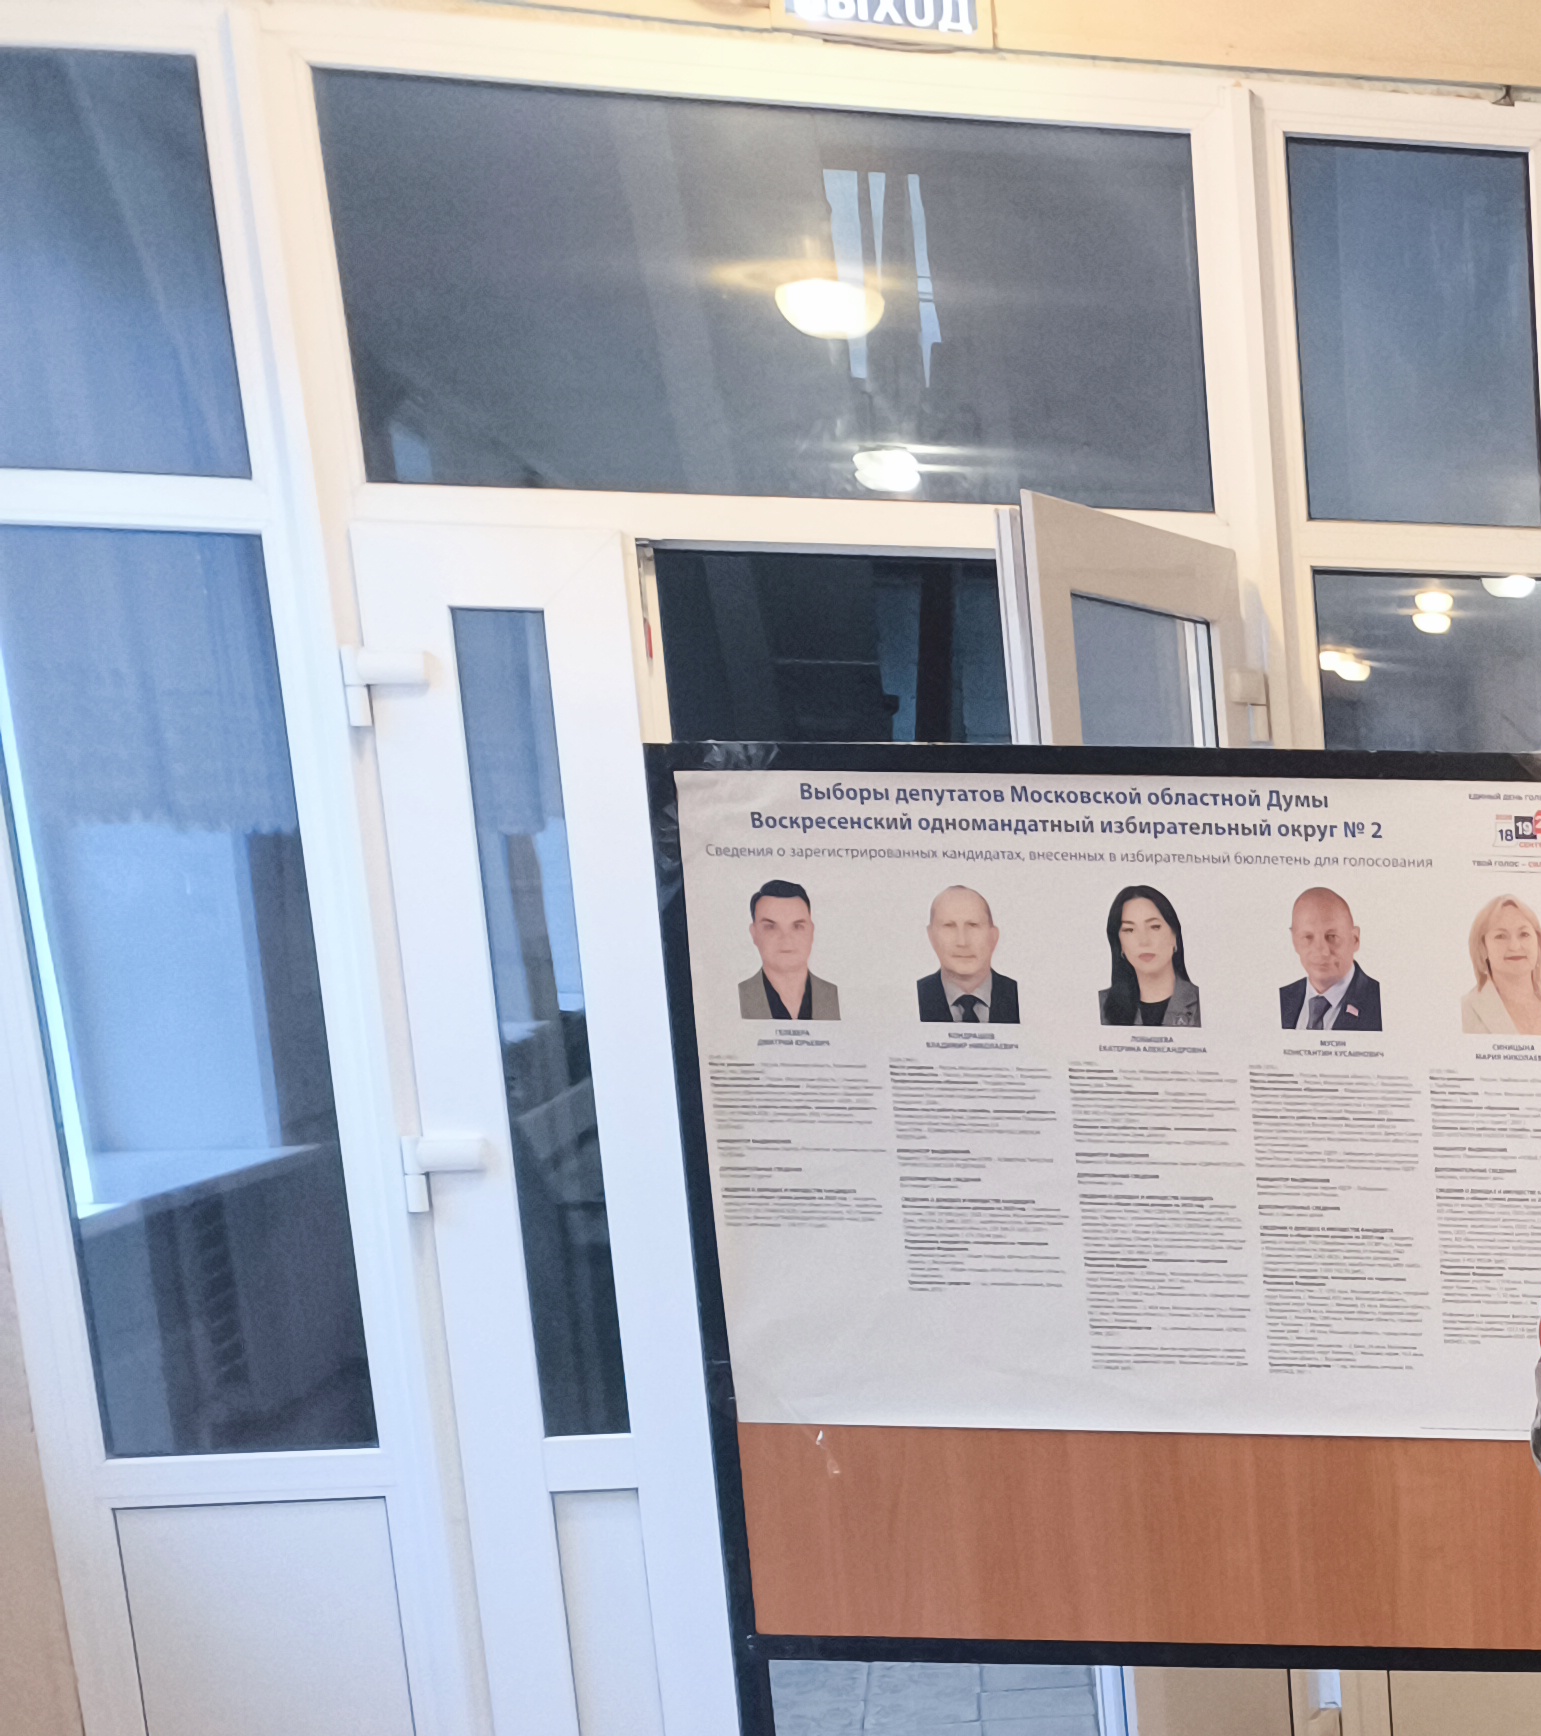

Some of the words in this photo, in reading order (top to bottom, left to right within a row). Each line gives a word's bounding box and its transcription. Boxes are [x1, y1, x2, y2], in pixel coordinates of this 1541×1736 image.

[800, 783, 889, 802] Выборы
[896, 786, 1005, 806] депутатов
[1010, 786, 1141, 805] Московской
[1148, 788, 1260, 808] областной
[1267, 790, 1328, 812] Думы
[750, 811, 912, 833] Воскресенский
[918, 816, 1094, 836] одномандатный
[1100, 816, 1271, 838] избирательный
[1277, 823, 1337, 842] округ
[1344, 822, 1364, 838] №
[1371, 822, 1383, 838] 2
[1499, 829, 1513, 841] 18
[1516, 822, 1532, 835] 19
[705, 843, 773, 860] Сведения
[777, 848, 785, 857] о
[790, 847, 937, 863] зарегистрированных
[942, 848, 1025, 863] кандидатах,
[1029, 850, 1105, 862] внесенных
[1109, 854, 1117, 862] в
[1120, 850, 1231, 866] избирательный
[1234, 851, 1310, 868] бюллетень
[1314, 857, 1339, 868] для
[1343, 856, 1433, 868] голосования
